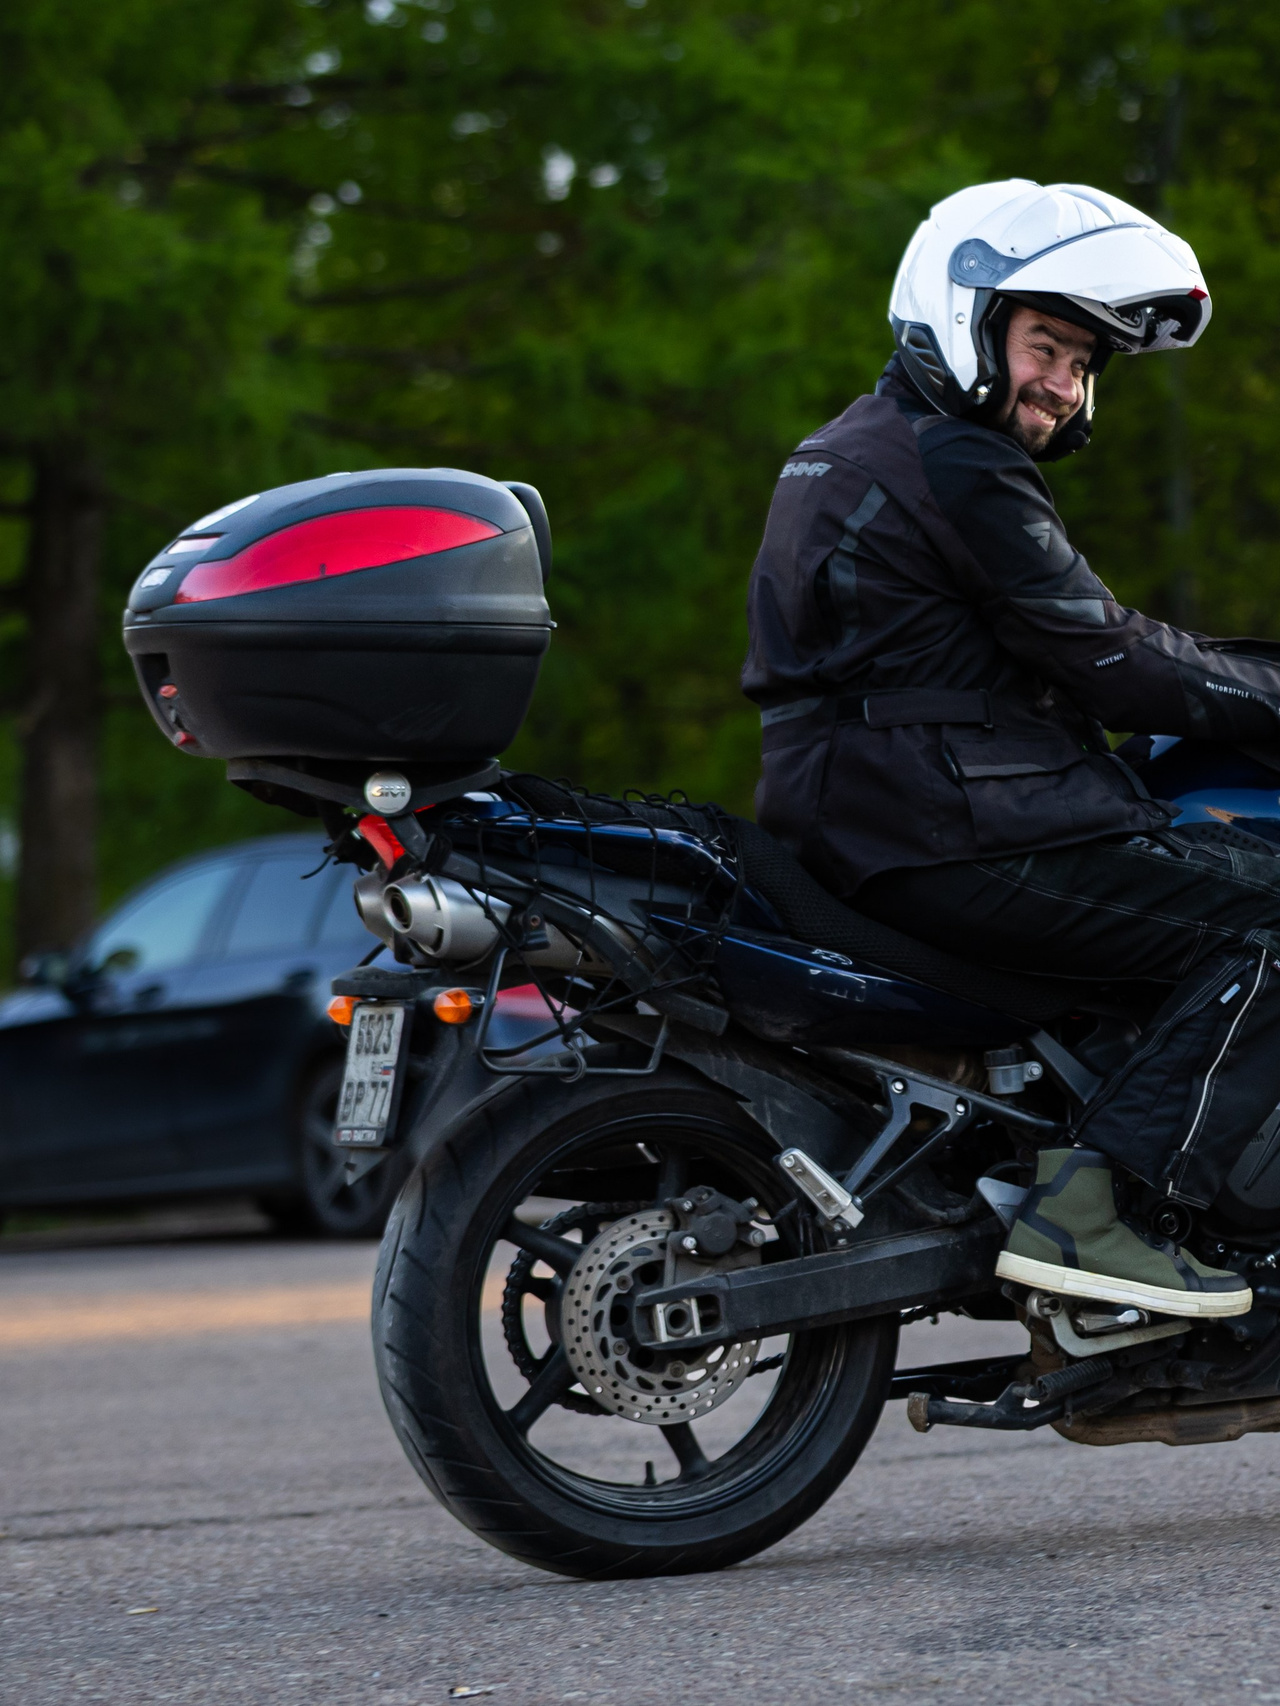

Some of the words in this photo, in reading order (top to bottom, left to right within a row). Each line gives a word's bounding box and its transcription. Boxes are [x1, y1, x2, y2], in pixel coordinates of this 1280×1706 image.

[780, 462, 833, 478] SHIMA
[1206, 681, 1249, 698] MOTORSTYLE
[371, 785, 406, 798] GIVI
[356, 1013, 394, 1054] 5523
